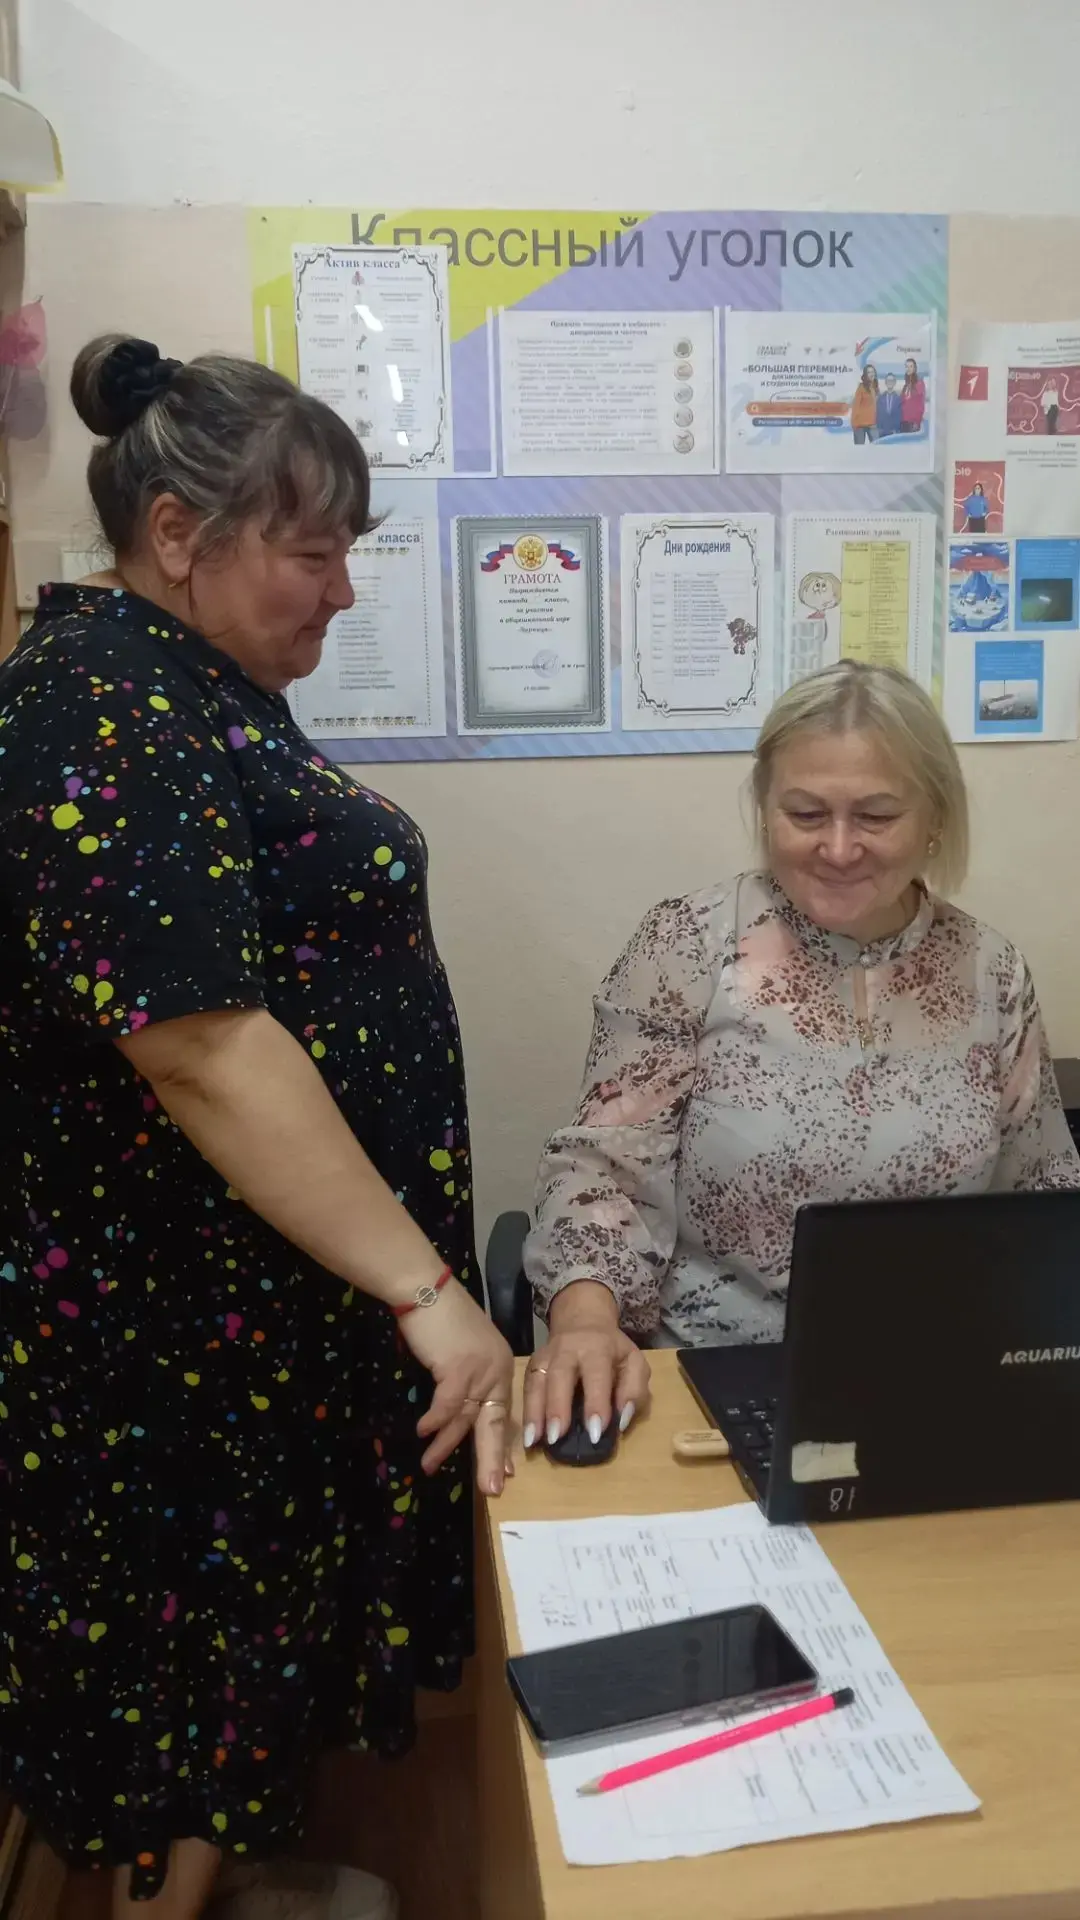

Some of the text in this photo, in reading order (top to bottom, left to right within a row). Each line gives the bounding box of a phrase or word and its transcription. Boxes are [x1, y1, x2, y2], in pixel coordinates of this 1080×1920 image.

[666, 229, 854, 282] уголок
[324, 258, 401, 269] Актив класса
[742, 364, 854, 374] «БОЛЬШАЯ ПЕРЕМЕНА»
[377, 534, 421, 544] класса
[664, 540, 731, 556] Дни рождения
[504, 573, 562, 585] ГРАМОТА
[1000, 1346, 1080, 1366] AQUARIU
